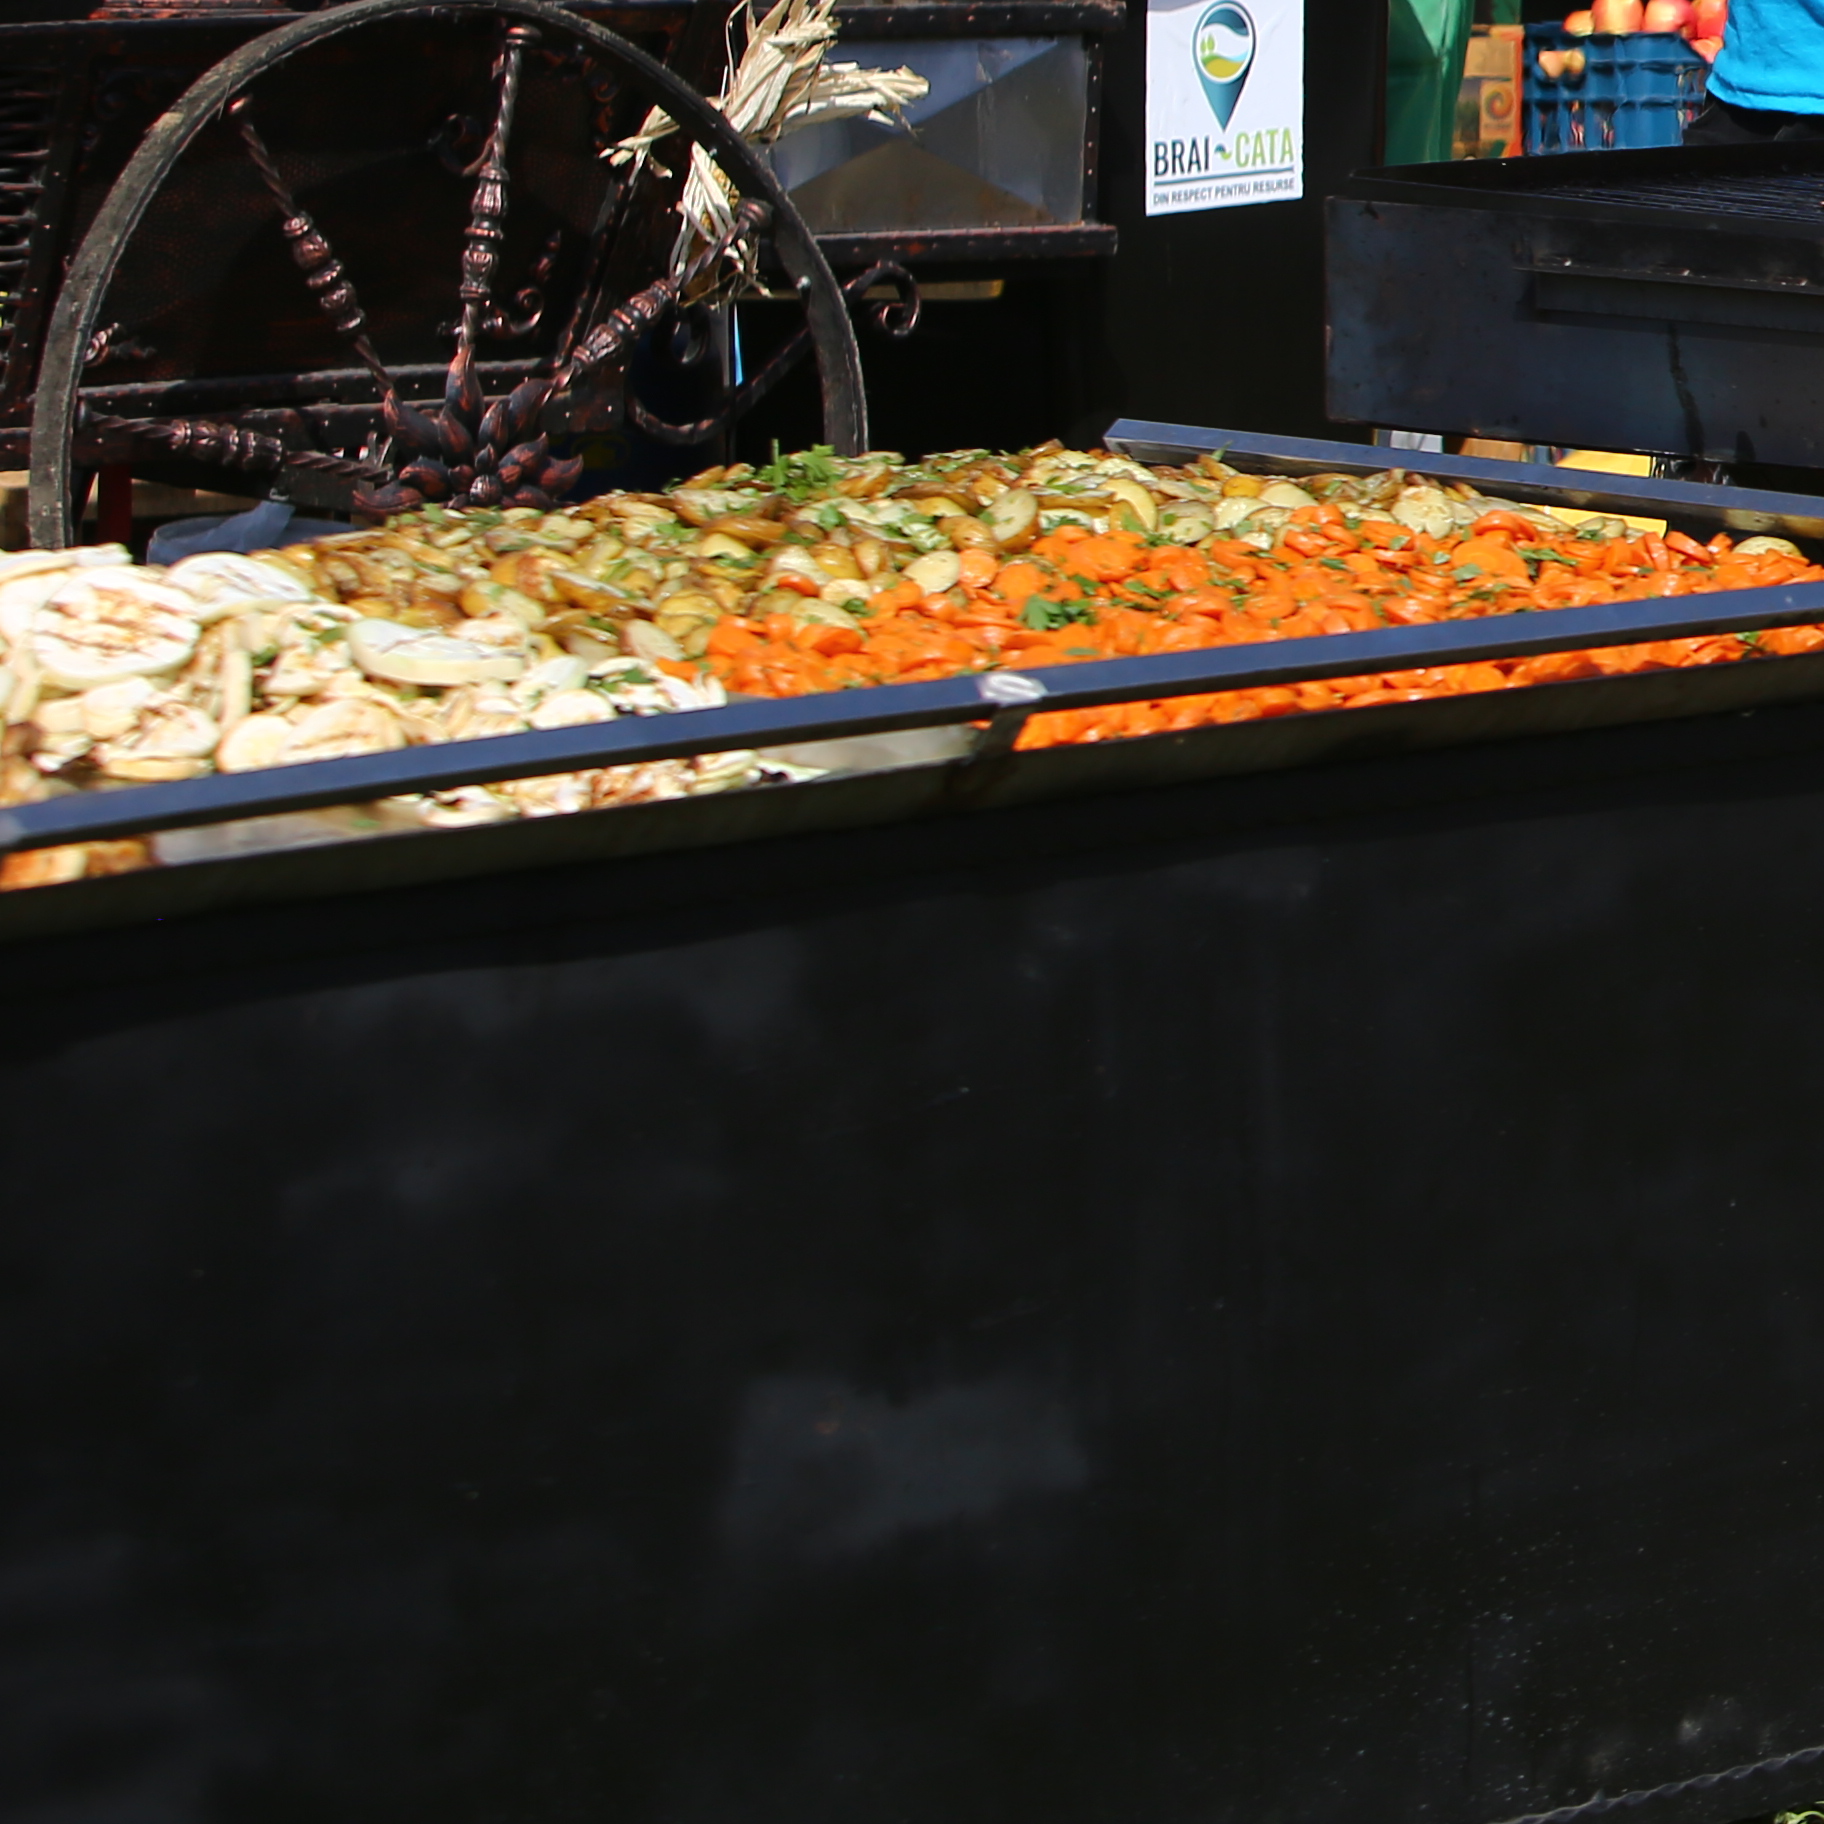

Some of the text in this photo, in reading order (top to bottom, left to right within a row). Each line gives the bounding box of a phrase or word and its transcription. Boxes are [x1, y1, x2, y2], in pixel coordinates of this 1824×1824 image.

[1153, 126, 1295, 178] BRAI CATA
[1152, 177, 1295, 207] DIN RESPECT PENTRU RESURSE
